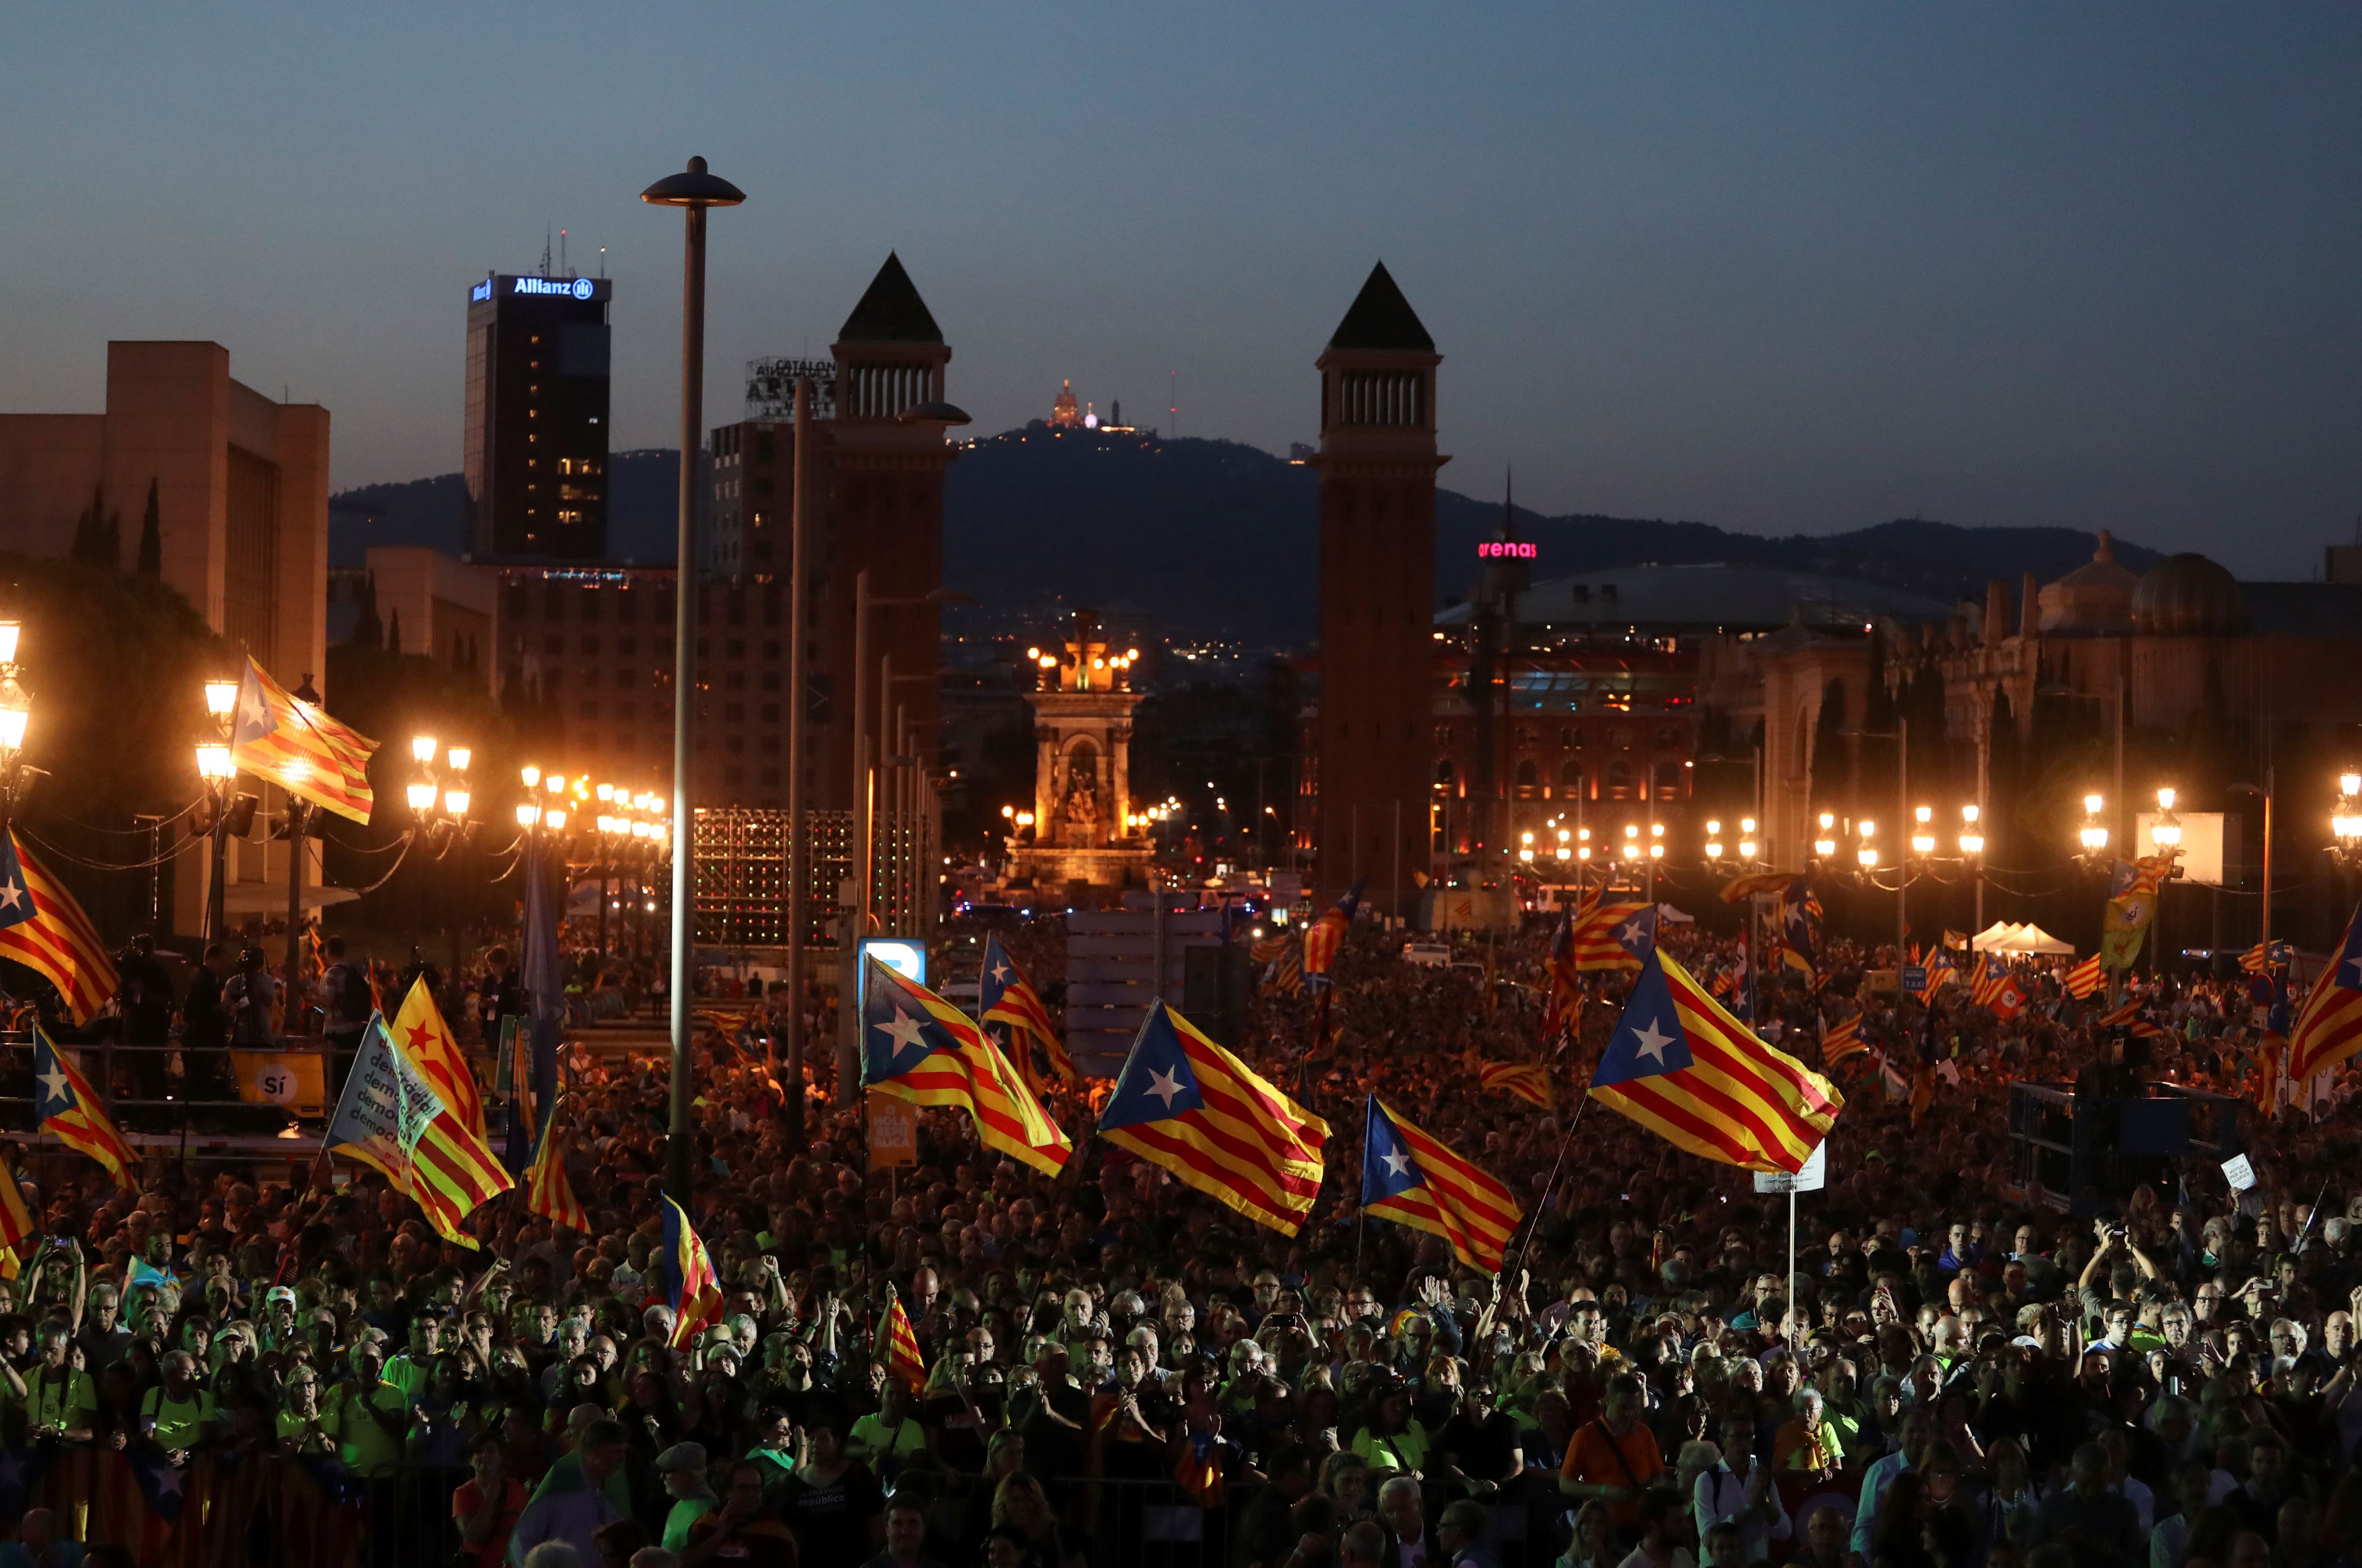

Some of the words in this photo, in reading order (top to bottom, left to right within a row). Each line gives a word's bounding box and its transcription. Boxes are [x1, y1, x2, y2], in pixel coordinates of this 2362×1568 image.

[514, 278, 571, 295] Allianz
[1478, 542, 1537, 558] arenas
[264, 1076, 286, 1094] Sí
